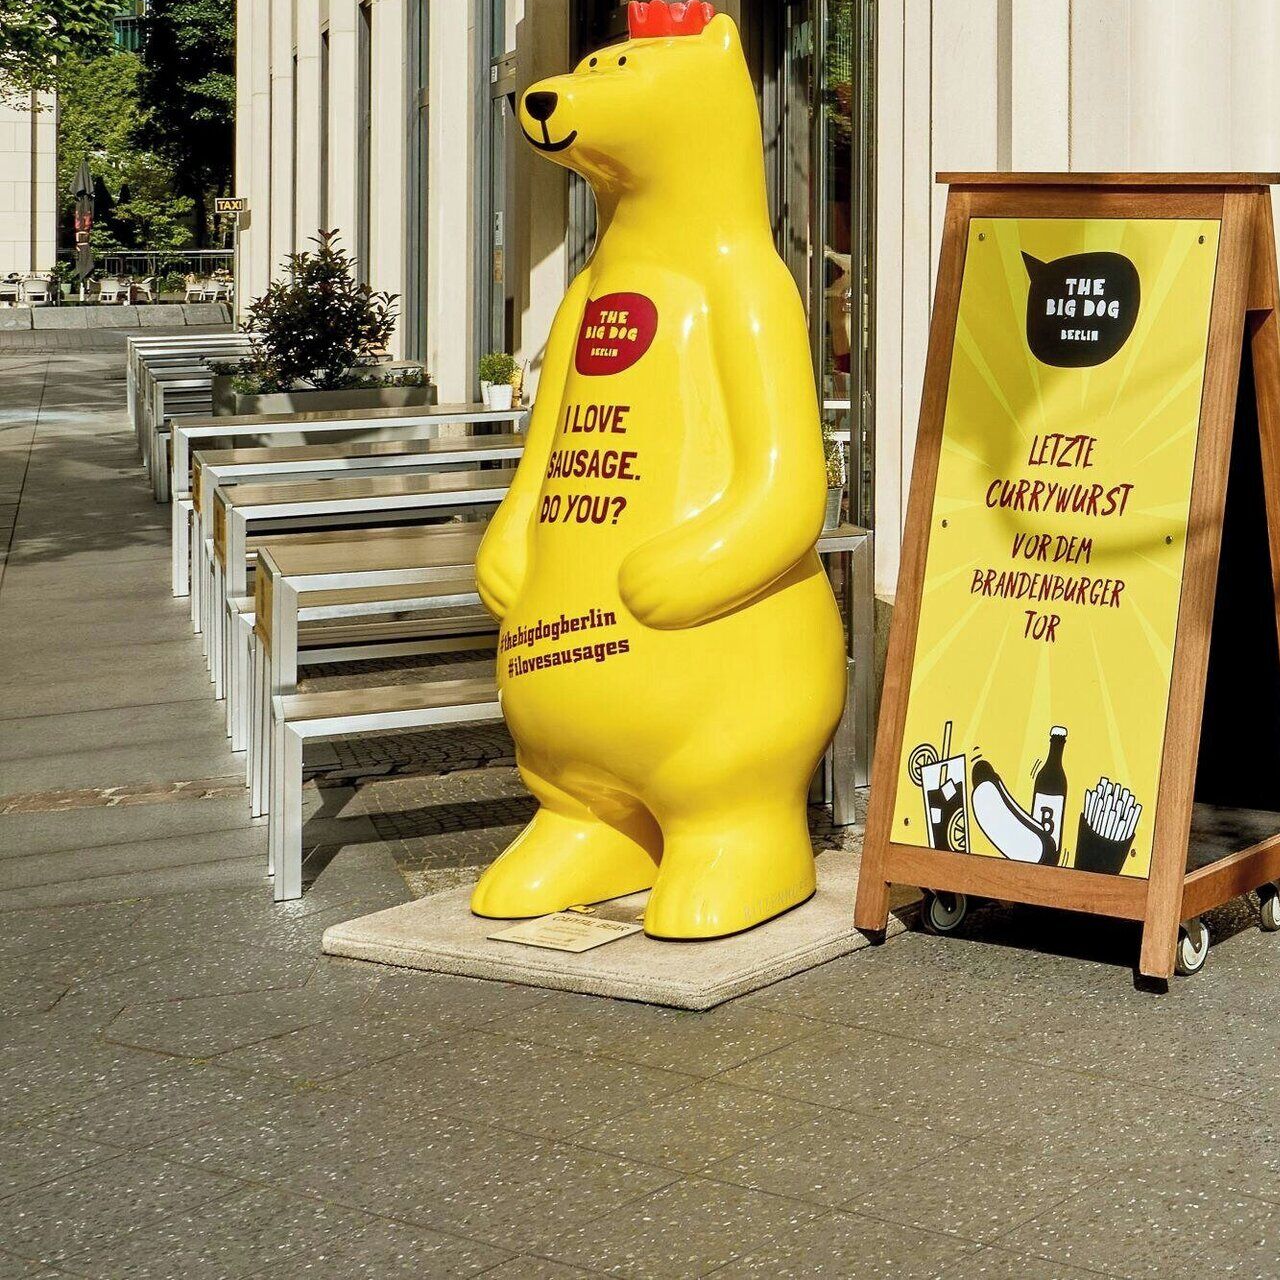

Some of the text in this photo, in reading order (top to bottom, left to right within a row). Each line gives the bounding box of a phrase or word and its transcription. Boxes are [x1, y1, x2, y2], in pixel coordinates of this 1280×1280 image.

[217, 200, 242, 210] TAXI
[1065, 278, 1106, 296] THE
[600, 310, 629, 324] THE
[1046, 298, 1120, 319] BIG DOG
[585, 325, 638, 342] BIG DOG
[1060, 329, 1099, 342] BERLIN
[590, 347, 619, 357] BERLIN
[563, 404, 630, 434] I LOVE
[547, 449, 641, 480] SAUSAGE.
[1028, 433, 1098, 468] LETZTE
[540, 494, 627, 525] DO YOU?
[985, 478, 1135, 517] CURRYWURST
[1011, 532, 1093, 564] VOR DEM
[970, 569, 1126, 608] BRANDENBURGER
[500, 608, 617, 653] #thebigdogberlin
[1024, 610, 1061, 643] TOR
[508, 639, 630, 678] #ilovesausages
[1041, 806, 1055, 835] B
